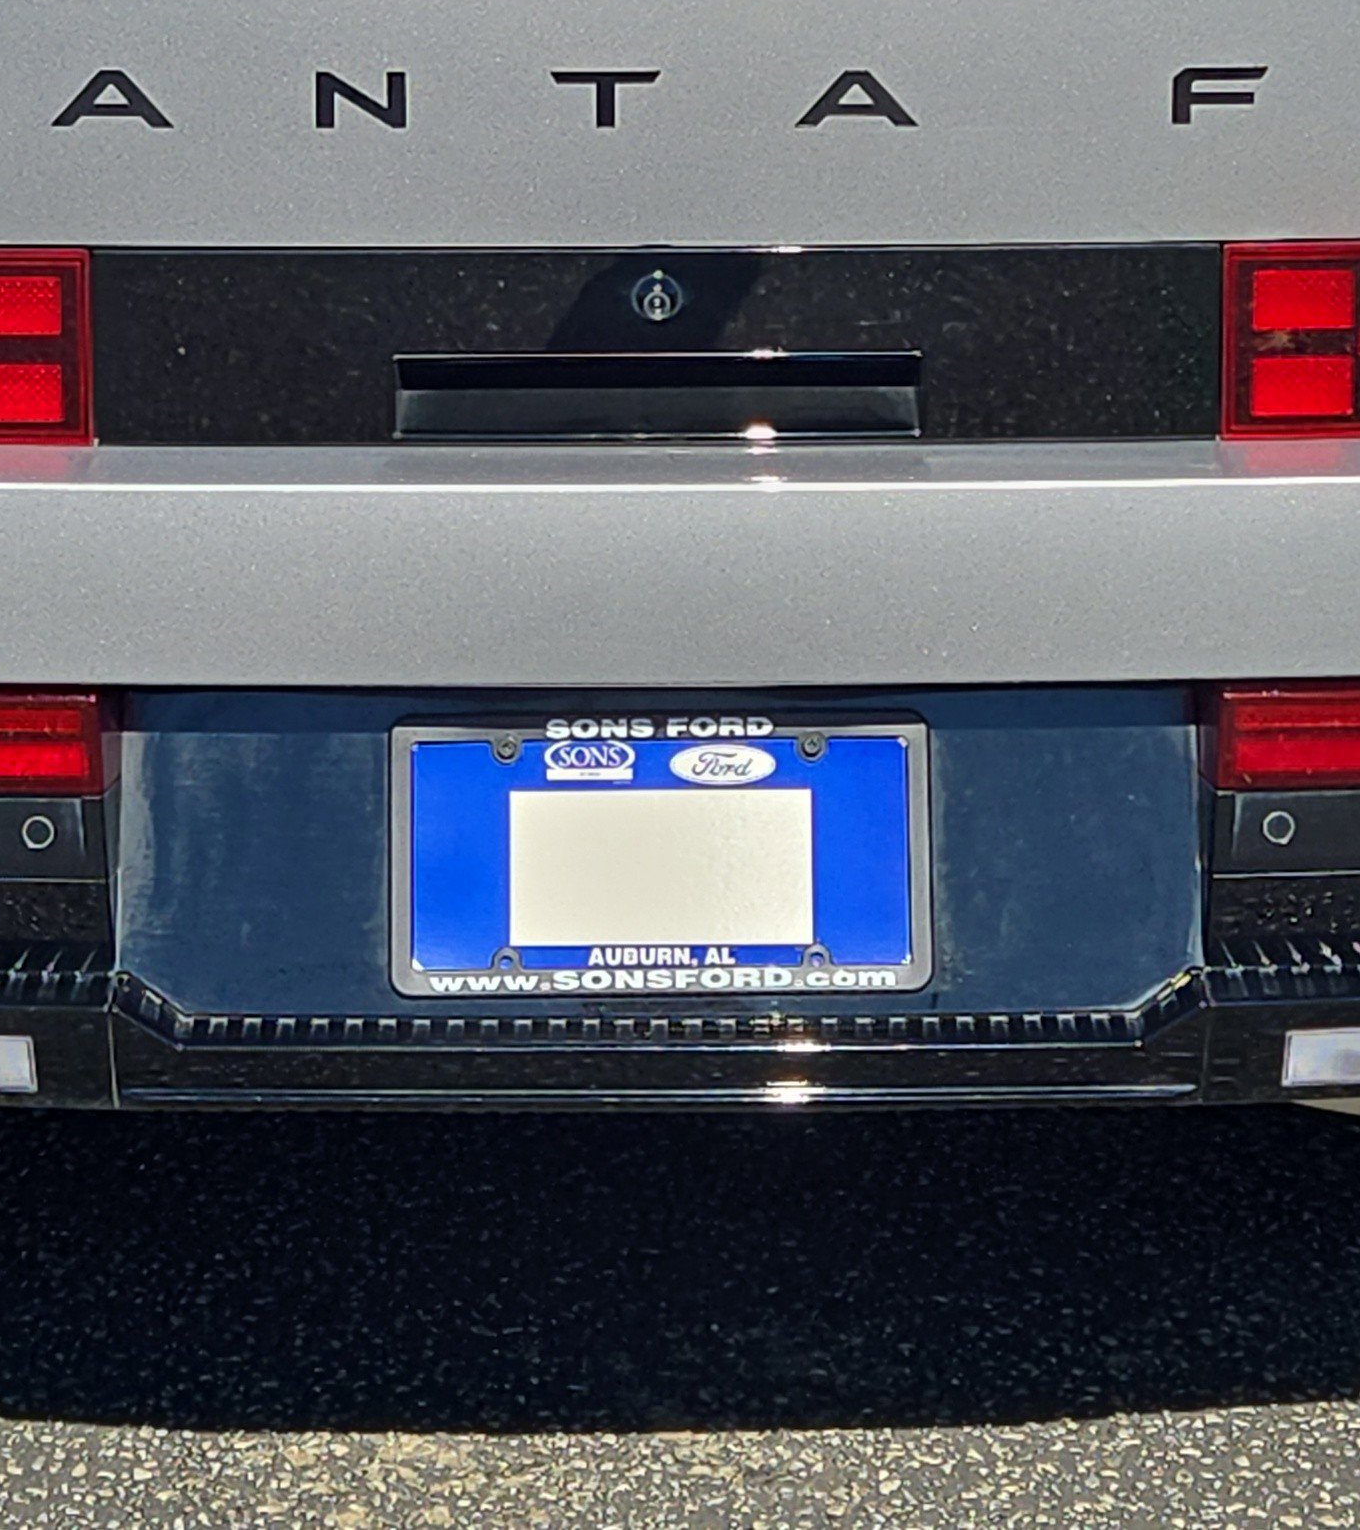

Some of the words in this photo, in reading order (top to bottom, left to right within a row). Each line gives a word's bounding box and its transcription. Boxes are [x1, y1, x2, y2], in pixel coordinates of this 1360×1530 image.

[546, 718, 655, 739] SONS
[666, 716, 775, 738] FORD
[557, 745, 622, 768] SONS
[691, 751, 755, 777] Ford
[587, 946, 698, 968] AUBURN,
[703, 945, 736, 966] AL
[428, 967, 899, 992] www.SONSFORD.com
